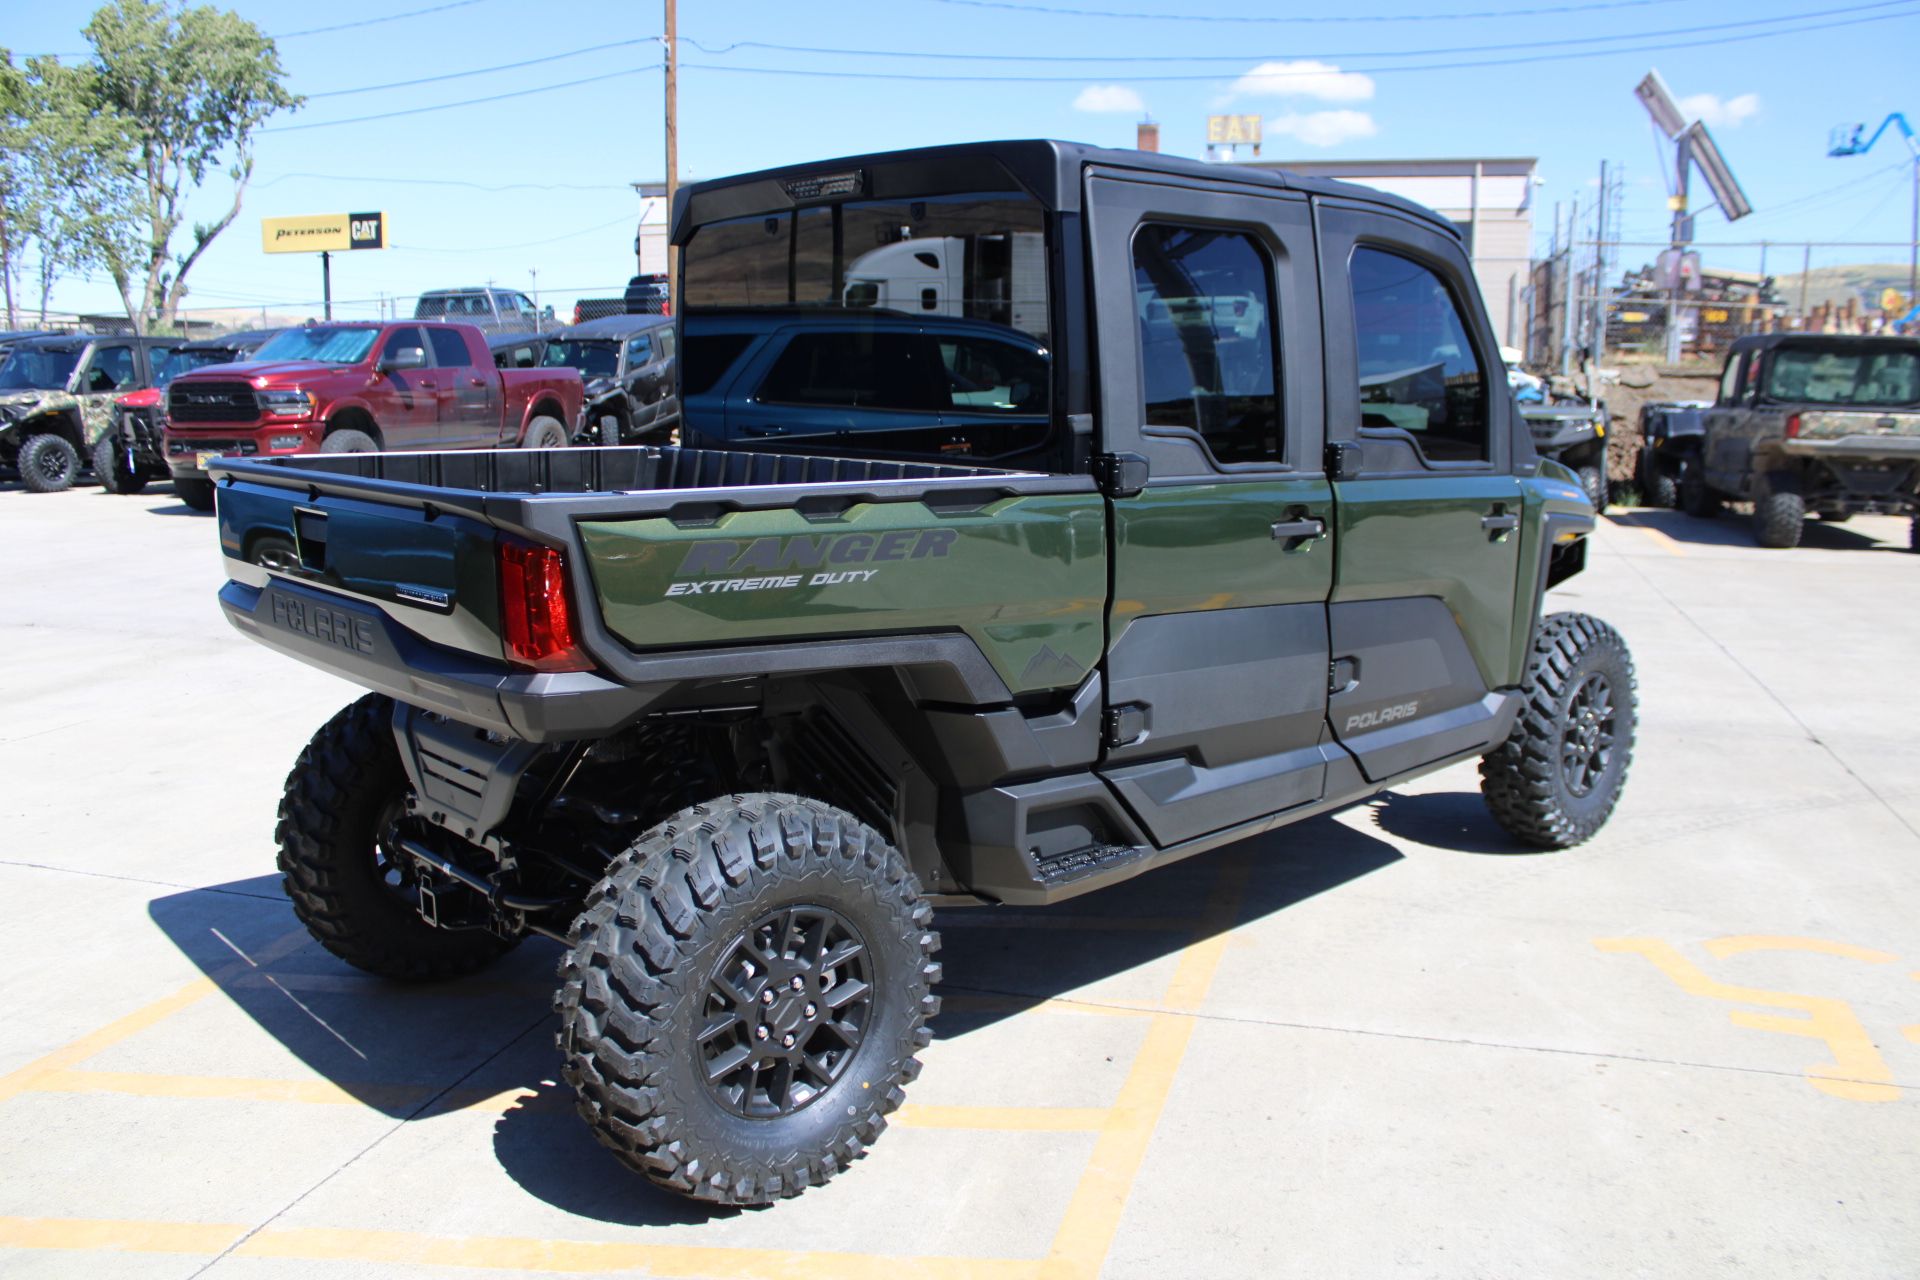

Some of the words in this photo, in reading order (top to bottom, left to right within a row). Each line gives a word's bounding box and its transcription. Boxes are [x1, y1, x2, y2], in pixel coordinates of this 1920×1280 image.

[1208, 115, 1260, 141] EAT
[351, 220, 378, 241] CAT
[674, 528, 959, 577] RANGER
[664, 574, 804, 597] EXTREME
[808, 569, 879, 586] DUTY
[271, 592, 376, 656] POLARIS
[1345, 701, 1419, 732] POLARIS
